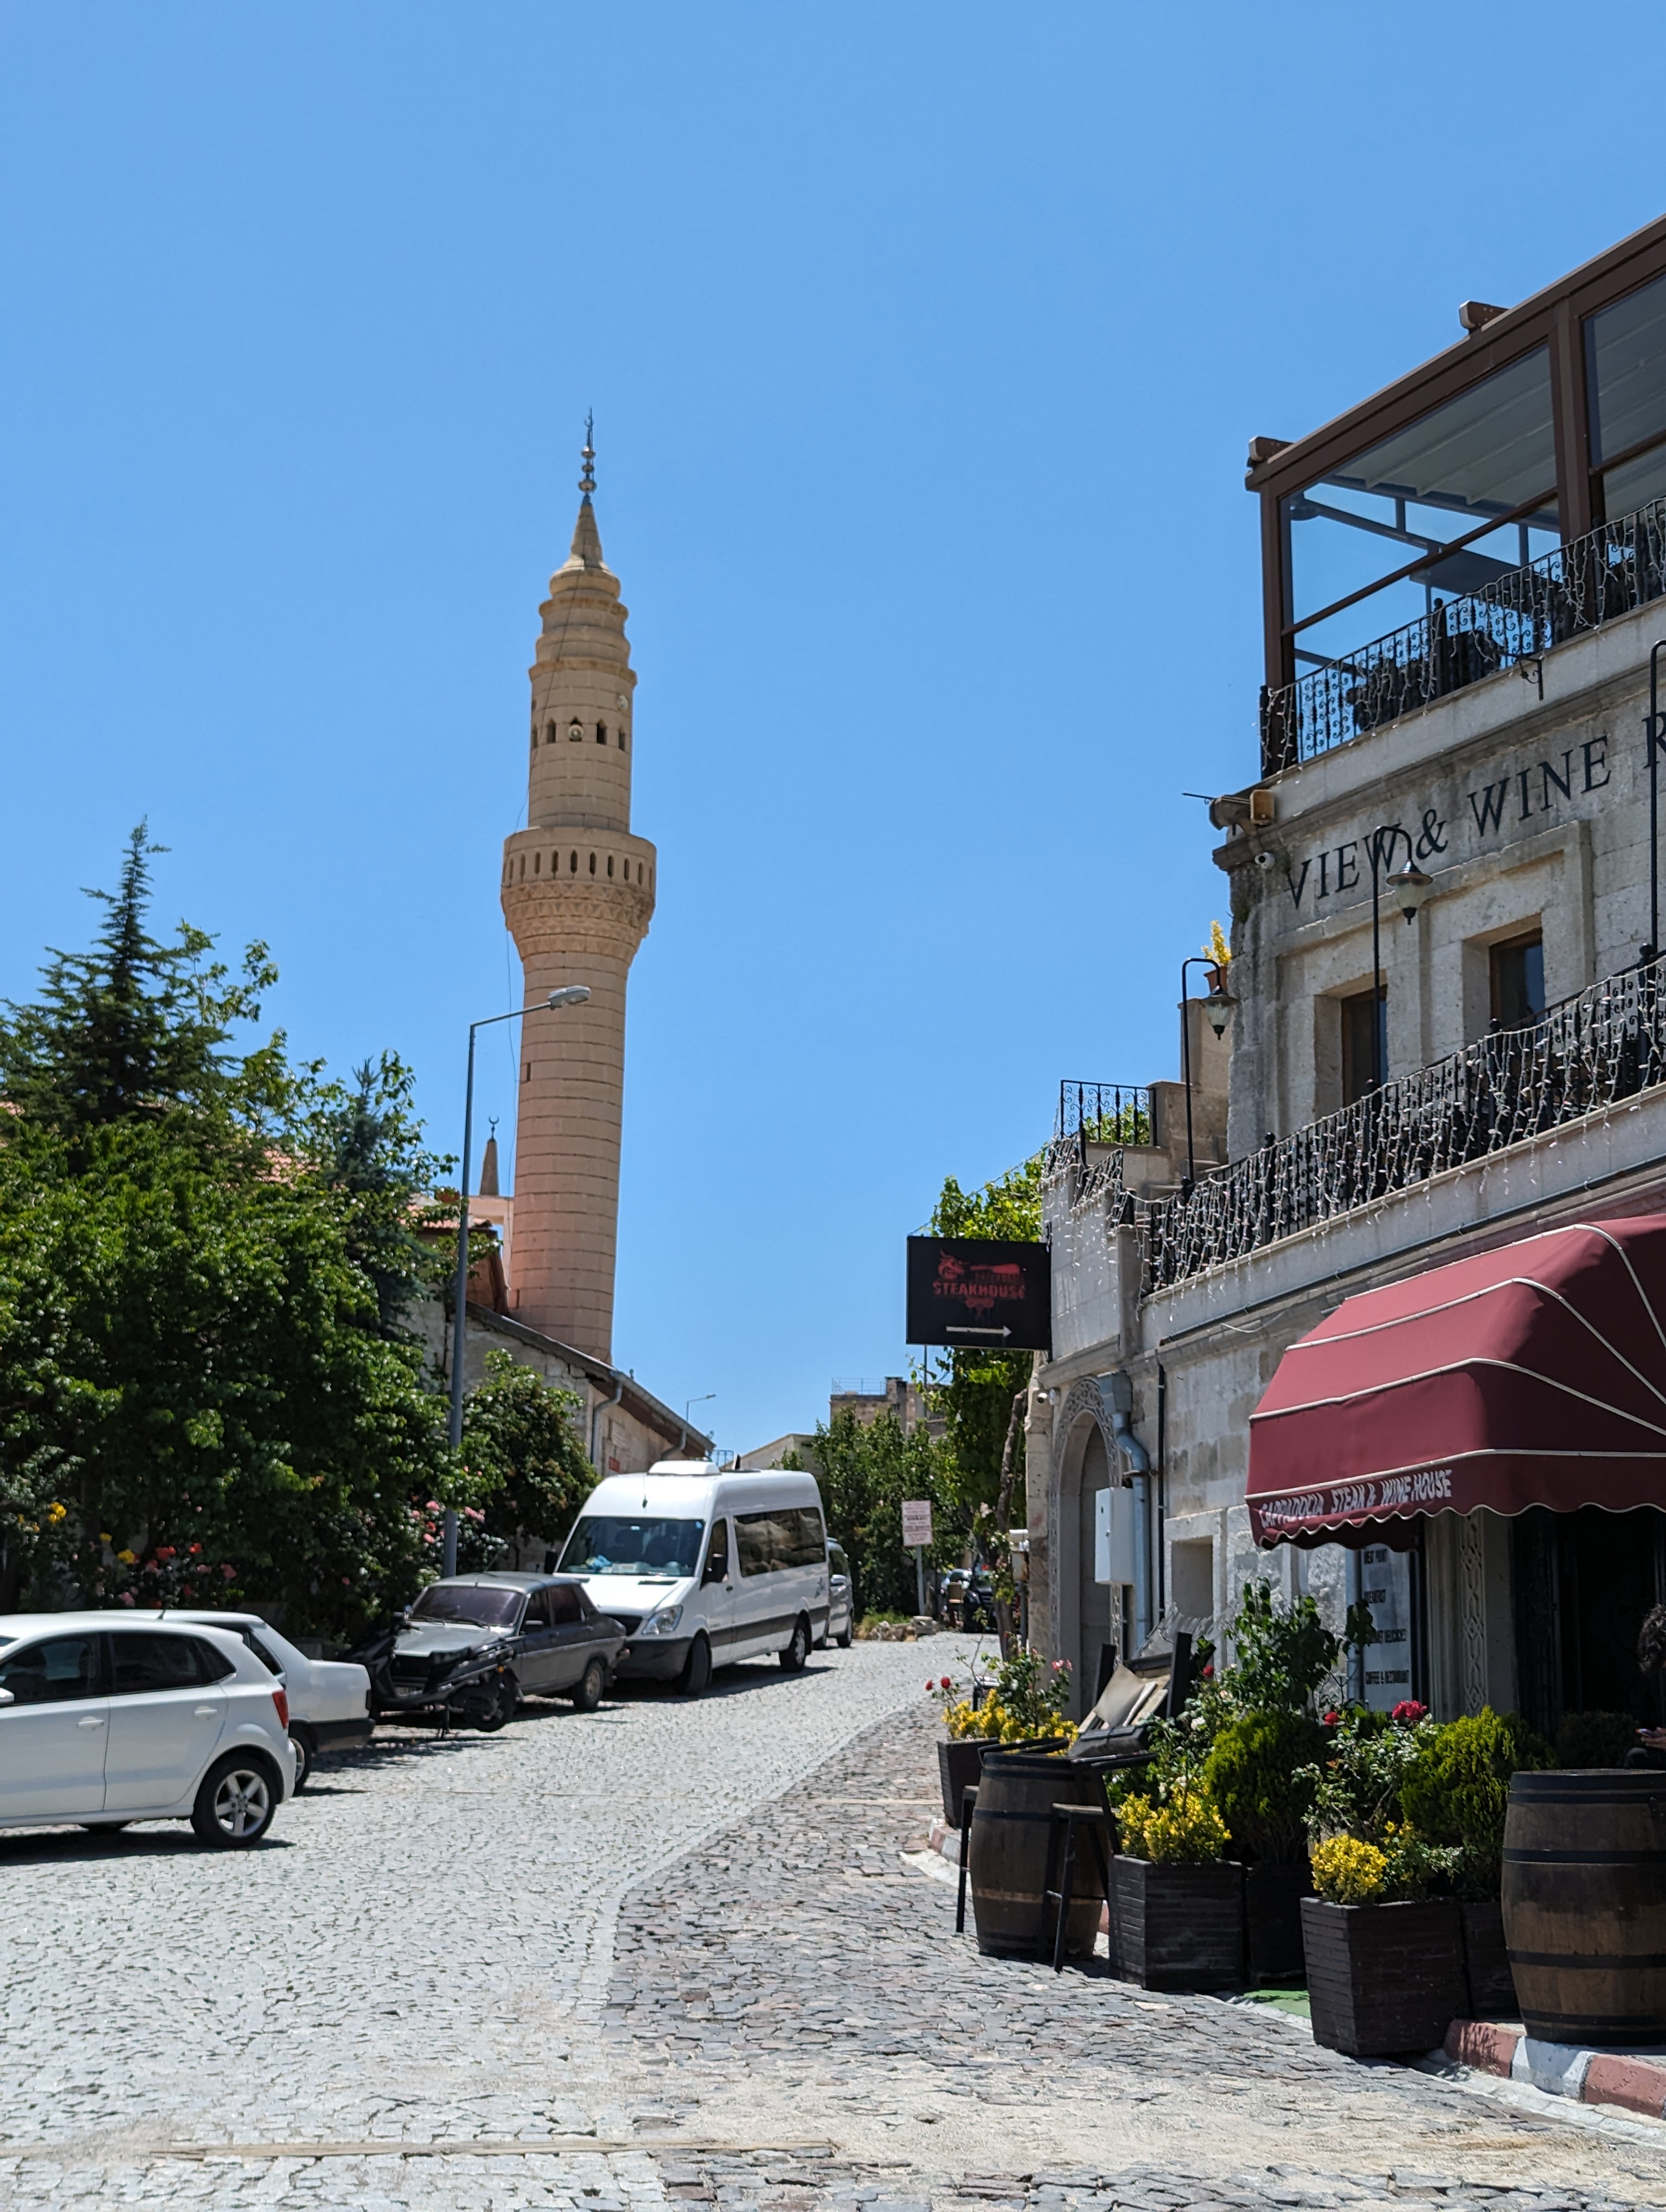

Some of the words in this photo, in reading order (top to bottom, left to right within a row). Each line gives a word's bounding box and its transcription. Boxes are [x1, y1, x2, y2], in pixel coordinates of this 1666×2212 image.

[1286, 822, 1402, 909] VIEW
[1415, 809, 1449, 860] &
[1466, 735, 1611, 837] WINE
[932, 1282, 1025, 1299] STEAKHOUSE
[1331, 1483, 1366, 1514] STEAK
[1366, 1482, 1376, 1507] &
[1379, 1475, 1412, 1506] WINE
[1411, 1469, 1452, 1501] HOUSE
